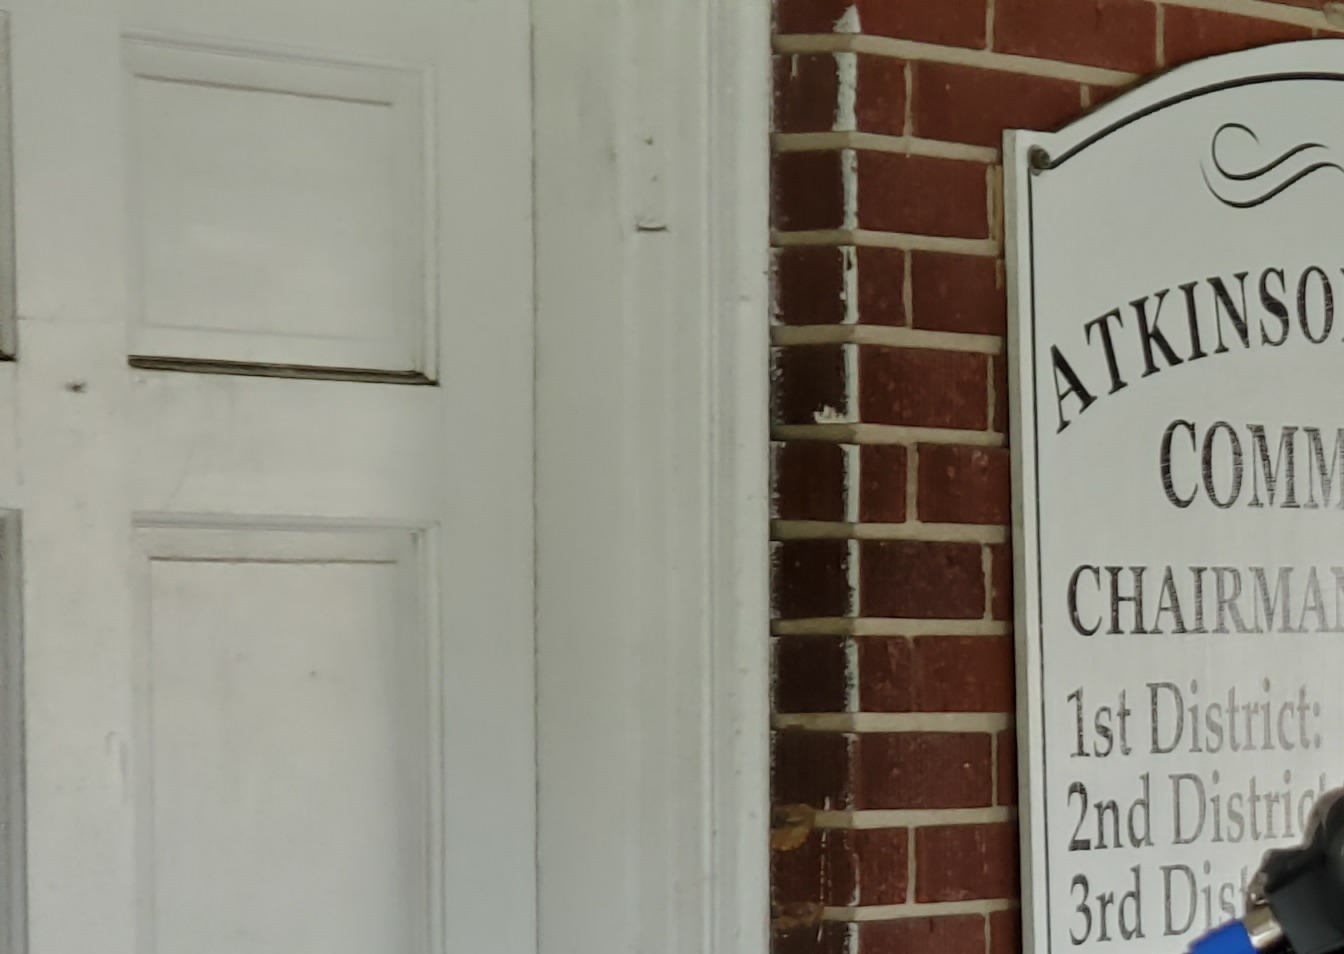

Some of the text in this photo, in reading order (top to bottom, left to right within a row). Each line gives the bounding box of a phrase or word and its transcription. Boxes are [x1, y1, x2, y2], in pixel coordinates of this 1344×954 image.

[1066, 685, 1132, 758] 1st
[1145, 676, 1322, 755] District:
[1066, 771, 1154, 852] 2nd
[1069, 863, 1146, 946] 3rd
